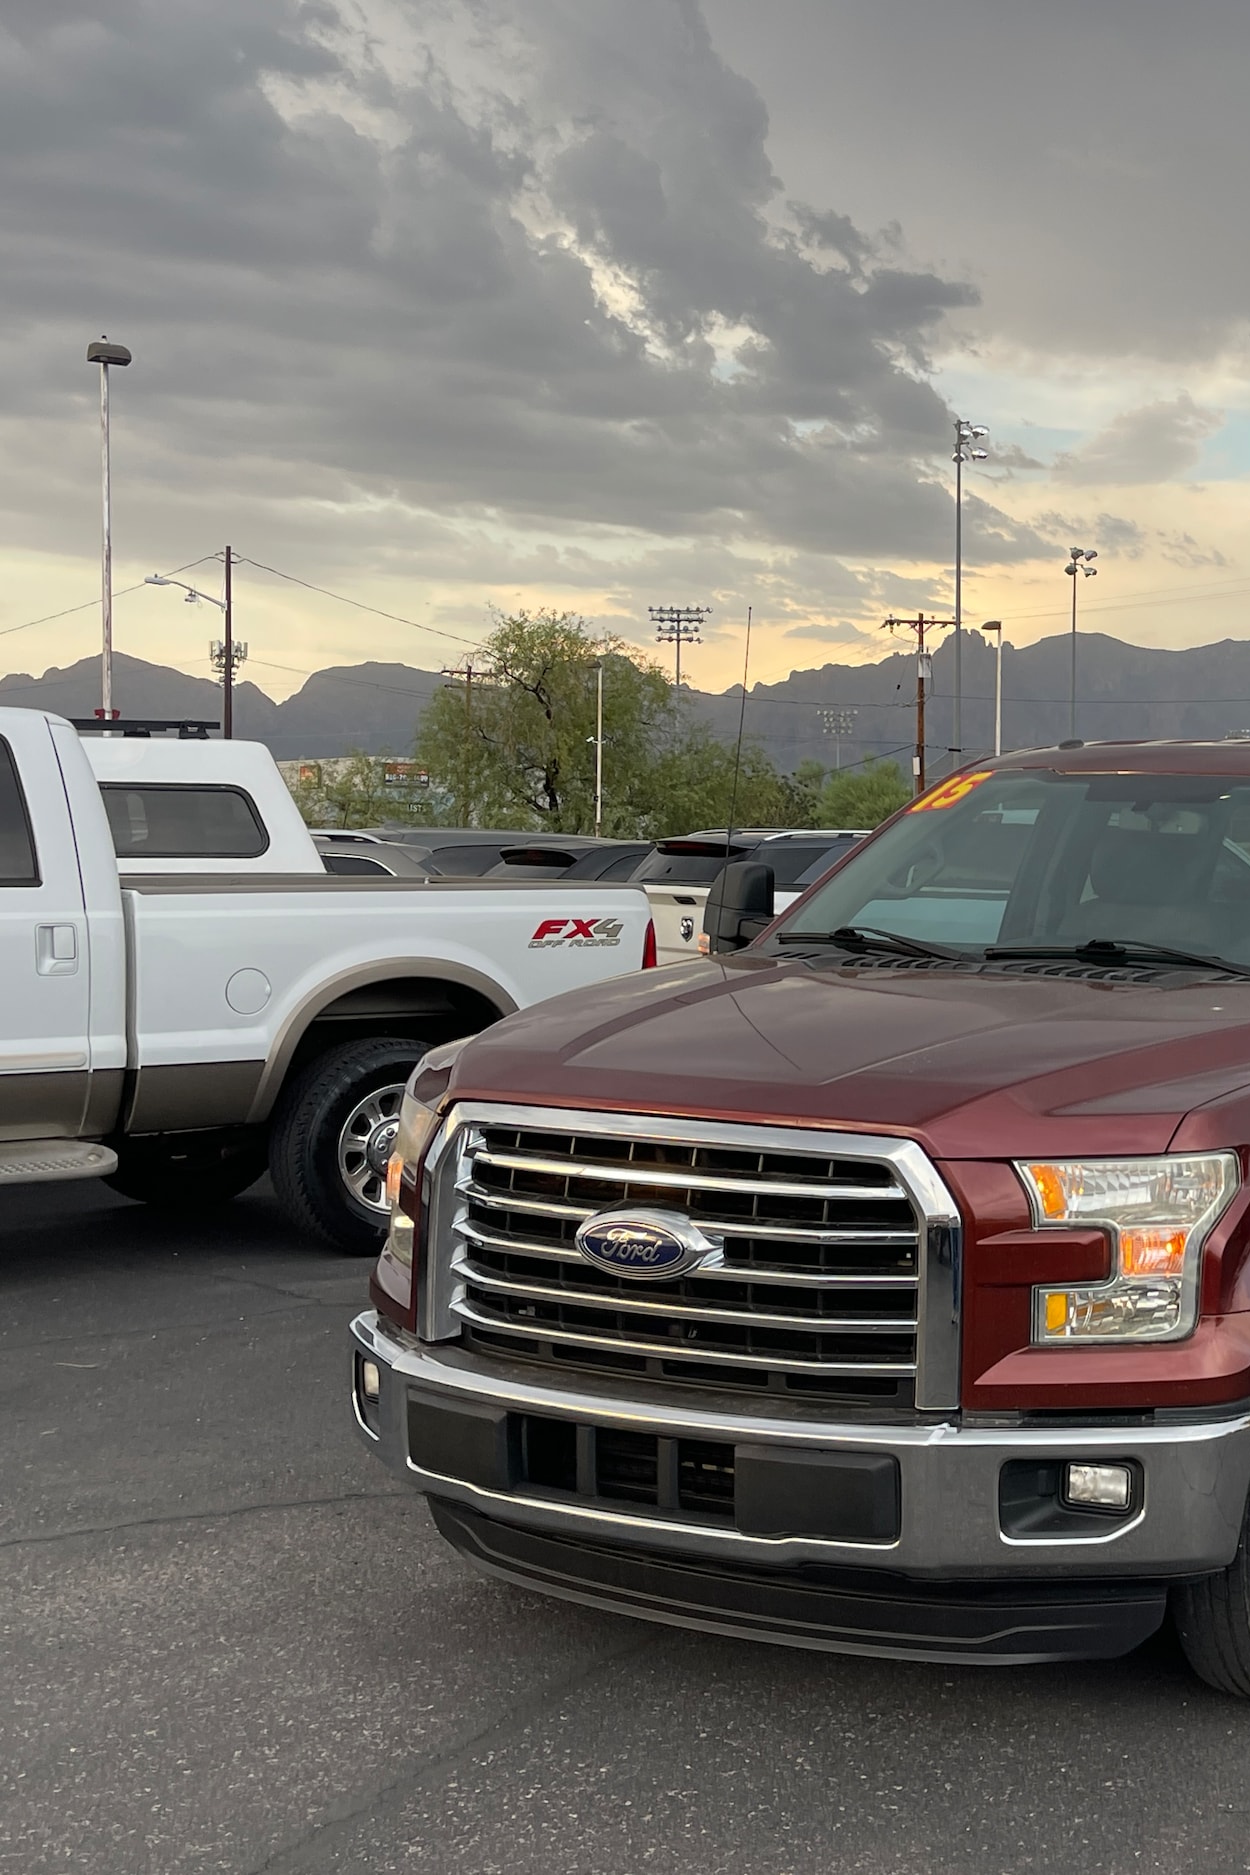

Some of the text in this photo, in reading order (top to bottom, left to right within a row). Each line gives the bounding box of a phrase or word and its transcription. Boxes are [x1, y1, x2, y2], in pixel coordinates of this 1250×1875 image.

[911, 771, 993, 812] 15
[532, 918, 624, 939] FX4
[528, 938, 621, 948] OFF ROAD
[600, 1227, 664, 1262] Ford
